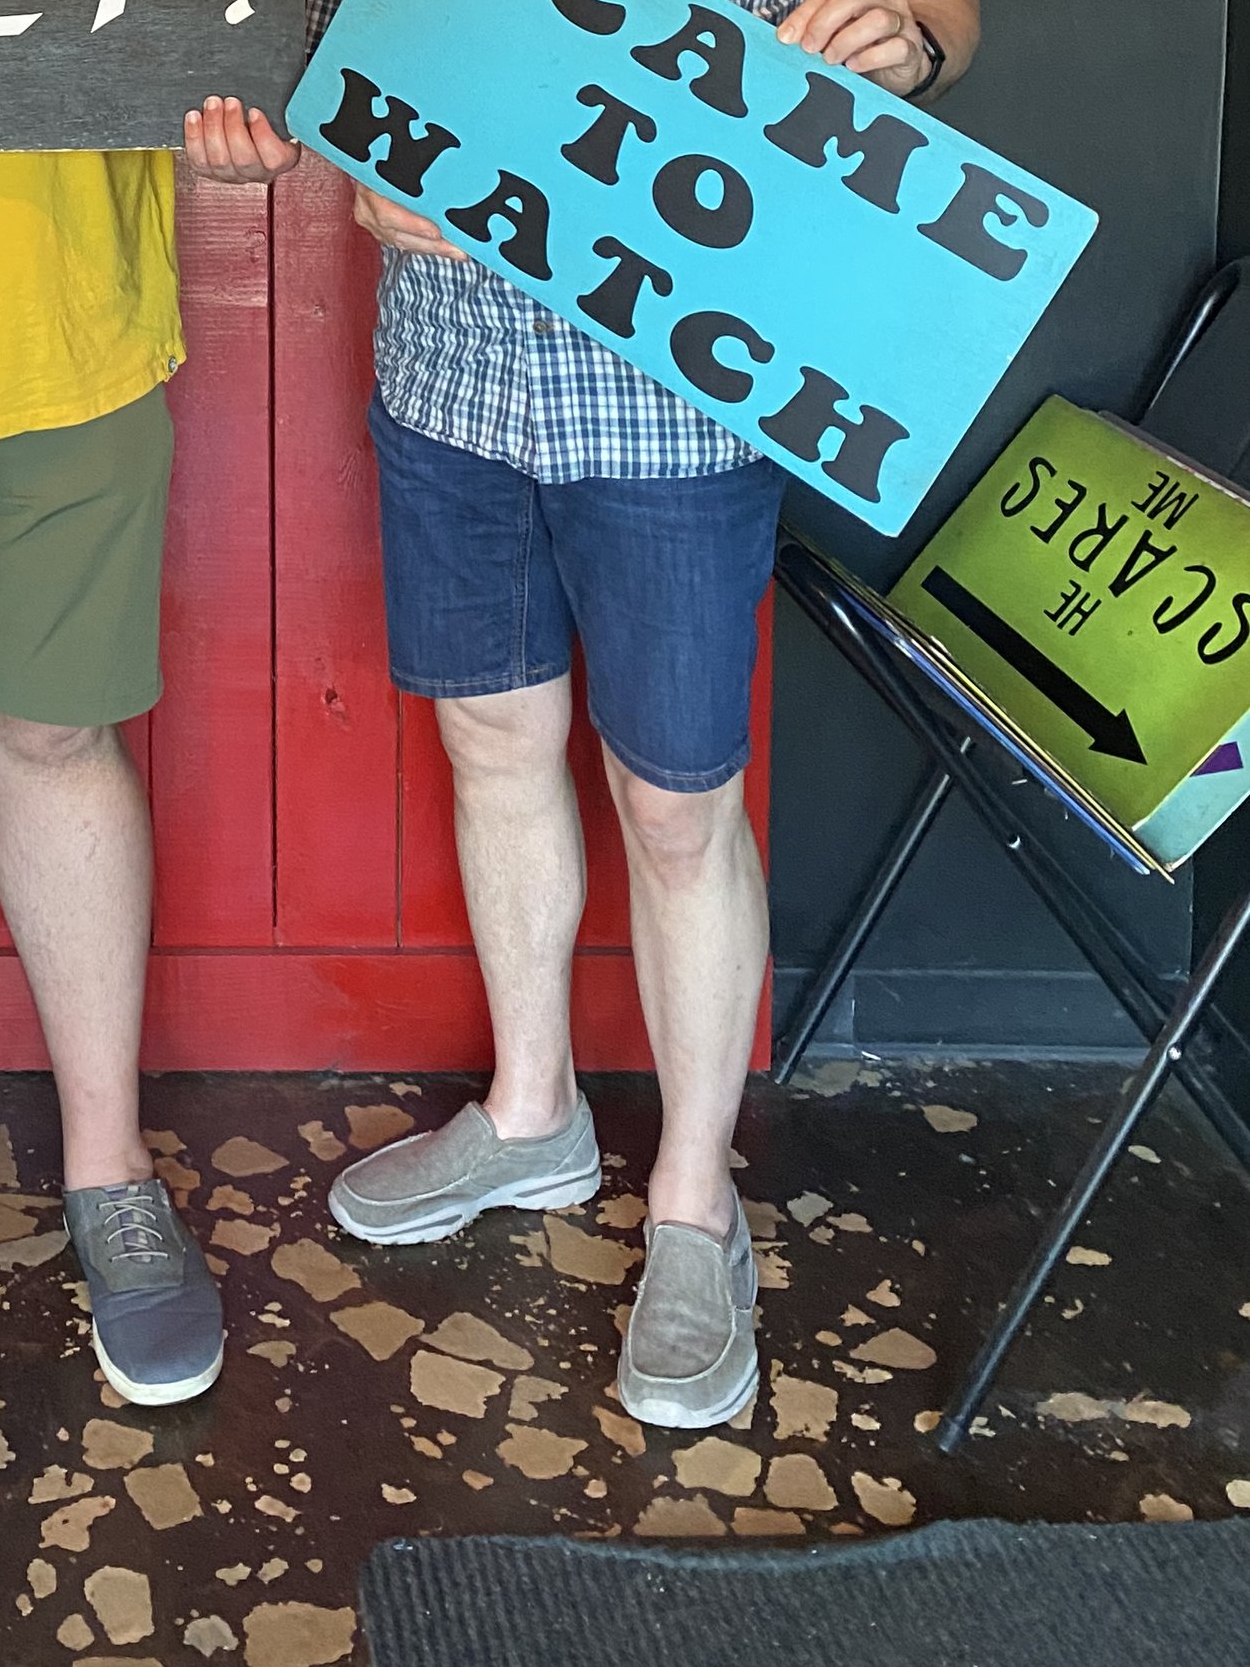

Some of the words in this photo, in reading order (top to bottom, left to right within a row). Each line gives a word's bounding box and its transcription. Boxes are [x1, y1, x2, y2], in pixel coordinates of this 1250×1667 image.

[560, 84, 754, 249] TO
[320, 68, 911, 503] WATCH
[1000, 456, 1250, 665] SCARES
[1131, 471, 1200, 530] ME
[1043, 580, 1102, 636] HE
